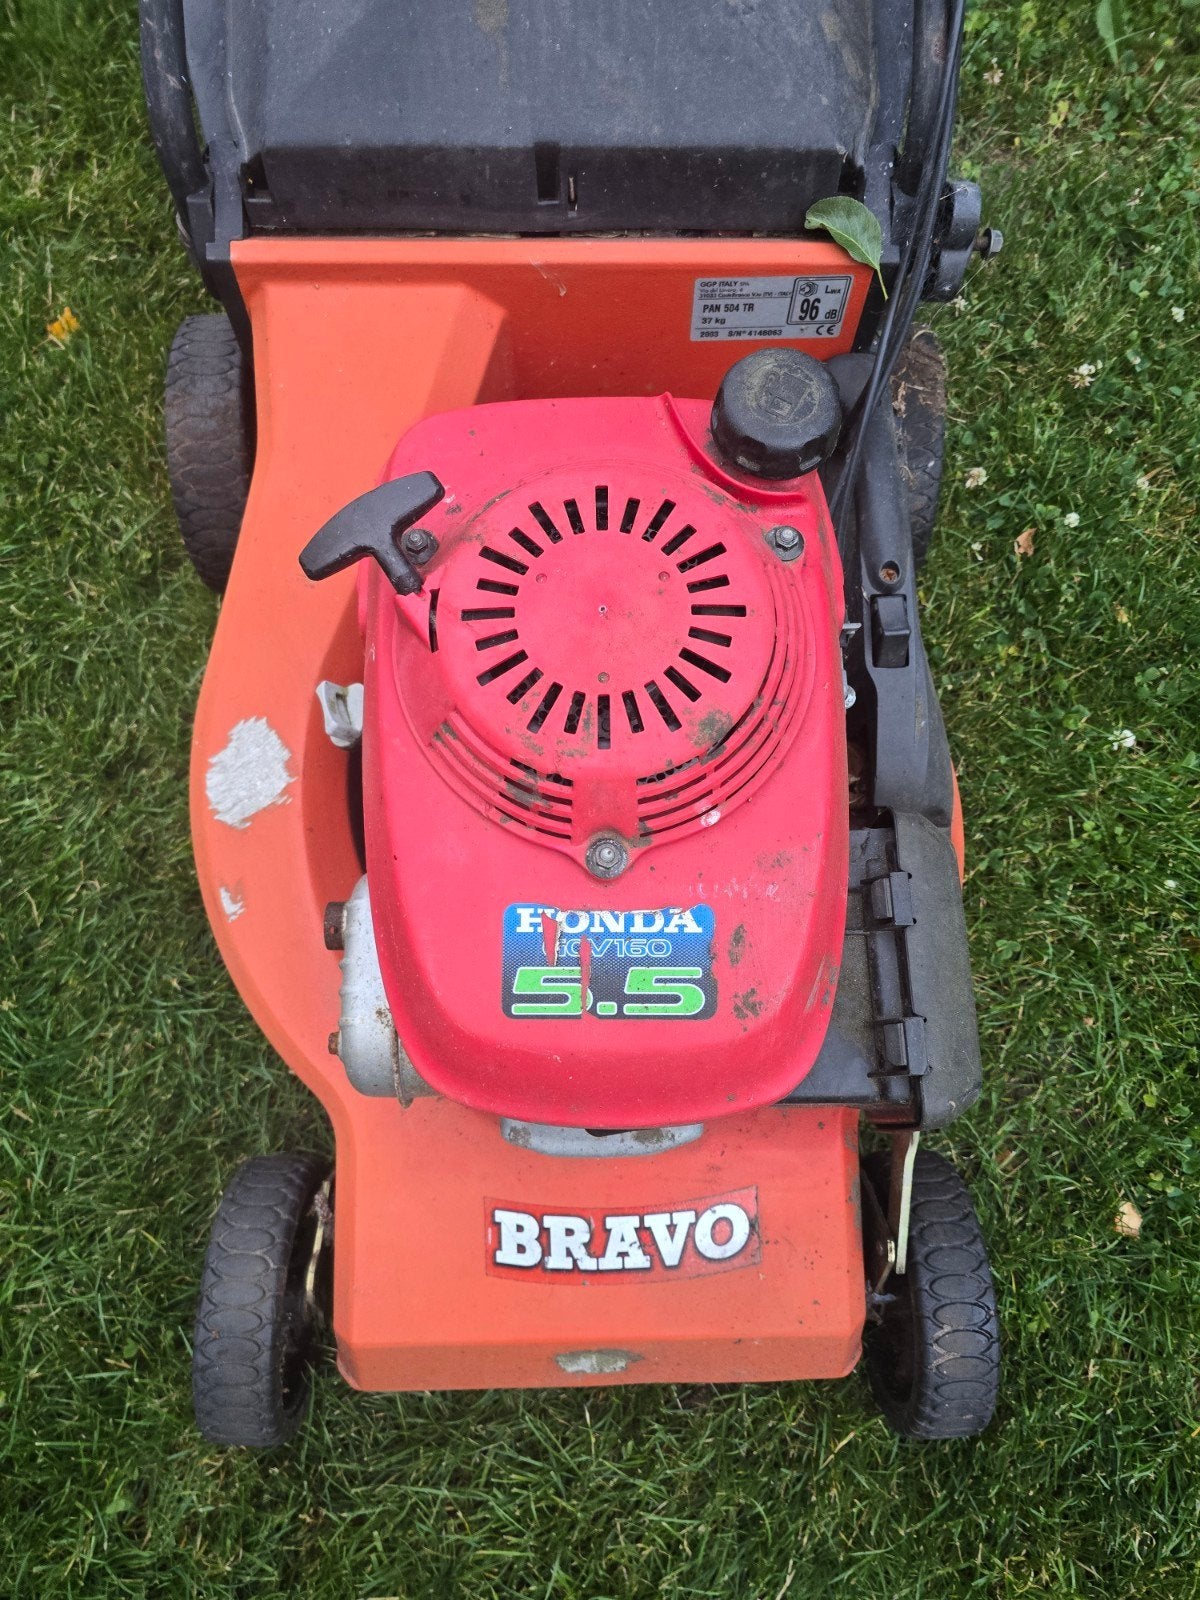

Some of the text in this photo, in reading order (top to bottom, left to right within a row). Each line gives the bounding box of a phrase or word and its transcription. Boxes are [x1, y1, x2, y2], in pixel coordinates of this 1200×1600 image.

[702, 303, 755, 313] PAN 504 TR
[798, 298, 821, 321] 96
[824, 309, 838, 320] dB
[701, 317, 727, 325] 37 kg
[516, 907, 703, 933] HONDA
[511, 966, 705, 1015] 5.5
[492, 1202, 751, 1272] BRAVO
